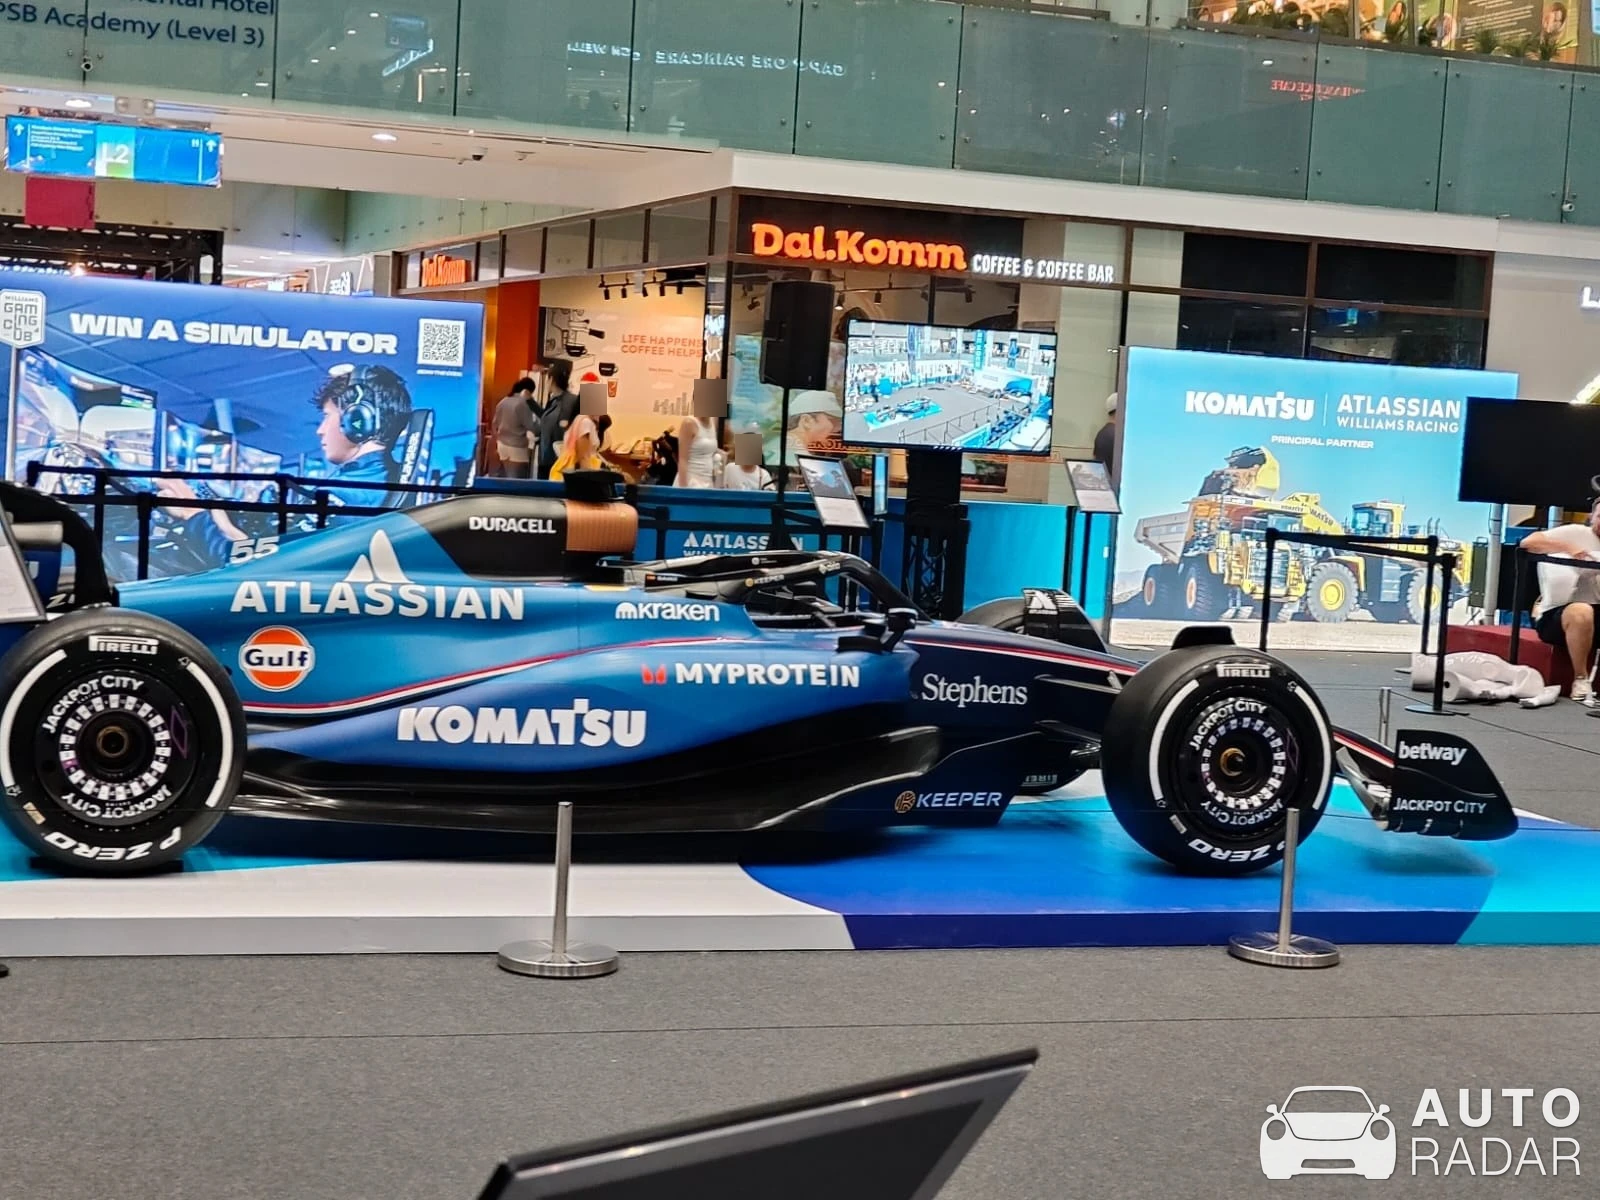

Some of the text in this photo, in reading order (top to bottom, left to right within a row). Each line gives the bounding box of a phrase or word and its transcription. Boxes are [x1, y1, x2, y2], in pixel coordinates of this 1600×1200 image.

[214, 0, 275, 15] Hotel
[44, 7, 160, 39] Academy
[168, 19, 236, 43] (Level
[243, 28, 265, 48] 3)
[102, 143, 129, 164] L2
[752, 223, 967, 271] Dal.Komm
[972, 254, 1114, 283] COFFEE & COFFEE BAR
[70, 312, 398, 355] WIN A SIMULATOR
[622, 334, 703, 348] LIFE HAPPENS
[621, 345, 703, 358] COFFEE HELPS
[1185, 391, 1314, 421] KOMATSU
[1337, 393, 1460, 419] ATLASSIAN
[1337, 416, 1459, 434] WILLIAMS RACING
[1272, 435, 1374, 449] PRINCIPAL PARTNER
[469, 516, 556, 534] DURACELL
[230, 536, 280, 564] 55
[701, 534, 804, 551] ATLASSN
[230, 581, 524, 620] ATLASSIAN
[89, 635, 159, 655] PIRELLI
[245, 648, 310, 669] Gulf
[1216, 663, 1271, 678] PIRELLI
[675, 663, 860, 687] MYPROTEIN
[921, 673, 1028, 708] Stephens
[42, 675, 144, 734] JACKPOT CITY
[397, 698, 646, 747] KOMATSU
[1189, 701, 1268, 751] JACKPOT CITY
[1398, 741, 1467, 766] betway
[61, 793, 101, 817] CITY
[101, 784, 172, 818] JACKPOT
[916, 792, 1002, 807] KEEPER
[1393, 798, 1487, 814] JACKPOT CITY
[44, 827, 182, 861] P ZERO
[1188, 839, 1272, 862] ZERO
